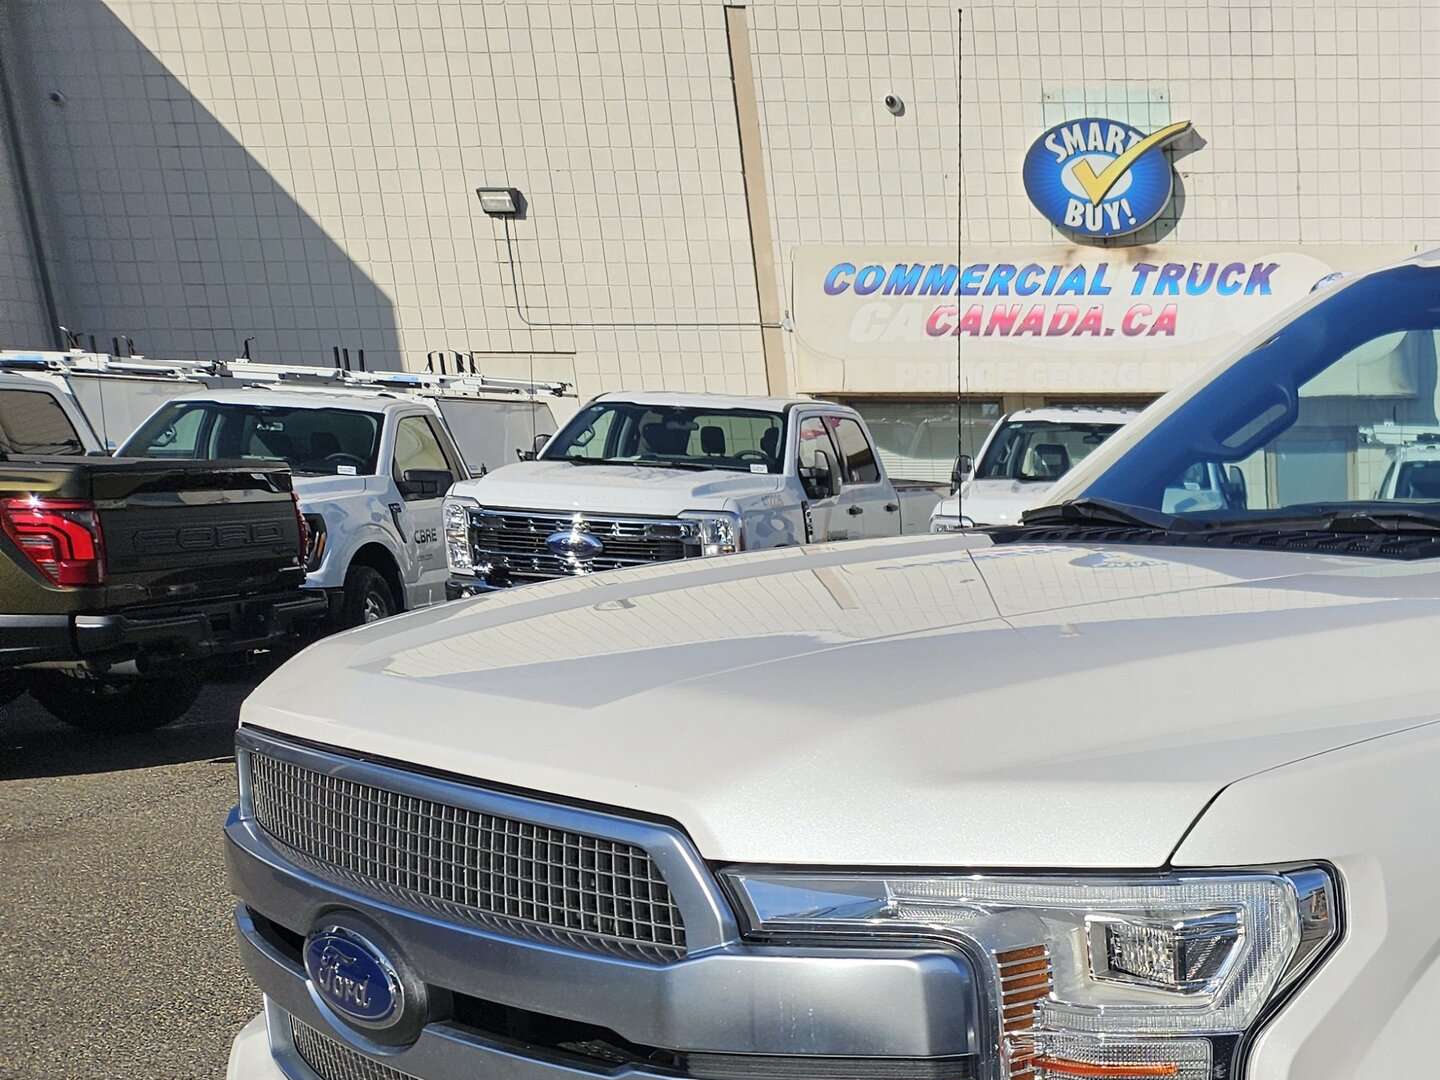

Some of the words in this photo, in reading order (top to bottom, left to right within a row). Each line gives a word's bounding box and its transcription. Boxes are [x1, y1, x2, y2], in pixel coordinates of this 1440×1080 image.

[1044, 121, 1143, 164] SMART
[1063, 198, 1138, 232] BUY!
[823, 261, 1113, 297] COMMERCIAL
[1130, 261, 1281, 297] TRUCK
[924, 303, 1177, 338] CANADA.CA
[132, 519, 285, 553] FORD
[414, 526, 438, 544] CBRE
[318, 944, 373, 1009] Ford
